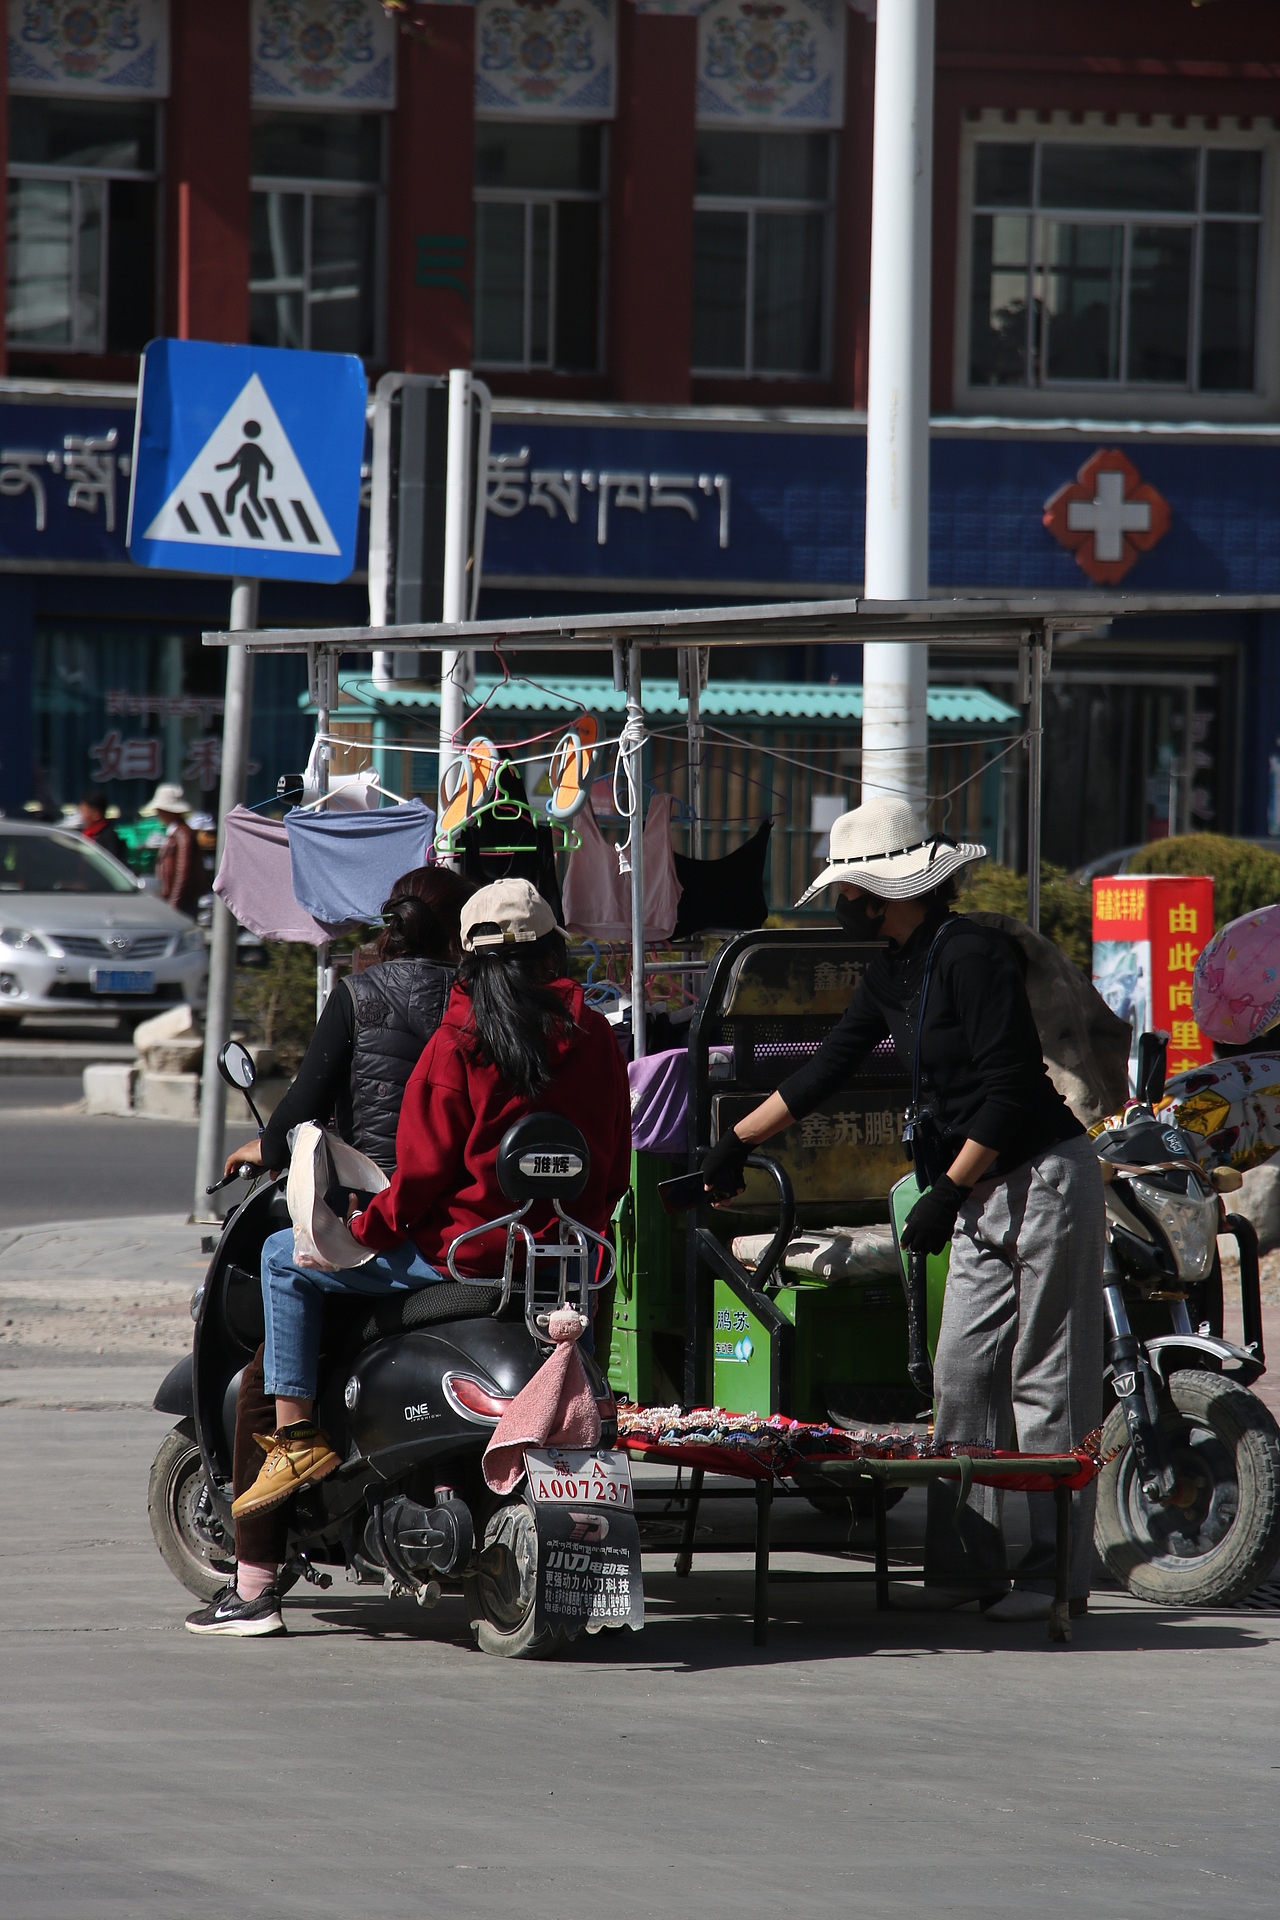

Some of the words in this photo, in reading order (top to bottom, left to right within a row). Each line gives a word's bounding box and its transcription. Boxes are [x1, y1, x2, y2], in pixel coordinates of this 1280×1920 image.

[813, 961, 869, 991] 鑫苏
[533, 1156, 570, 1174] 雅辉
[404, 1402, 429, 1421] ONE
[591, 1462, 608, 1479] A
[538, 1479, 629, 1504] A007237
[545, 1570, 631, 1594] 更强动力小刀科技
